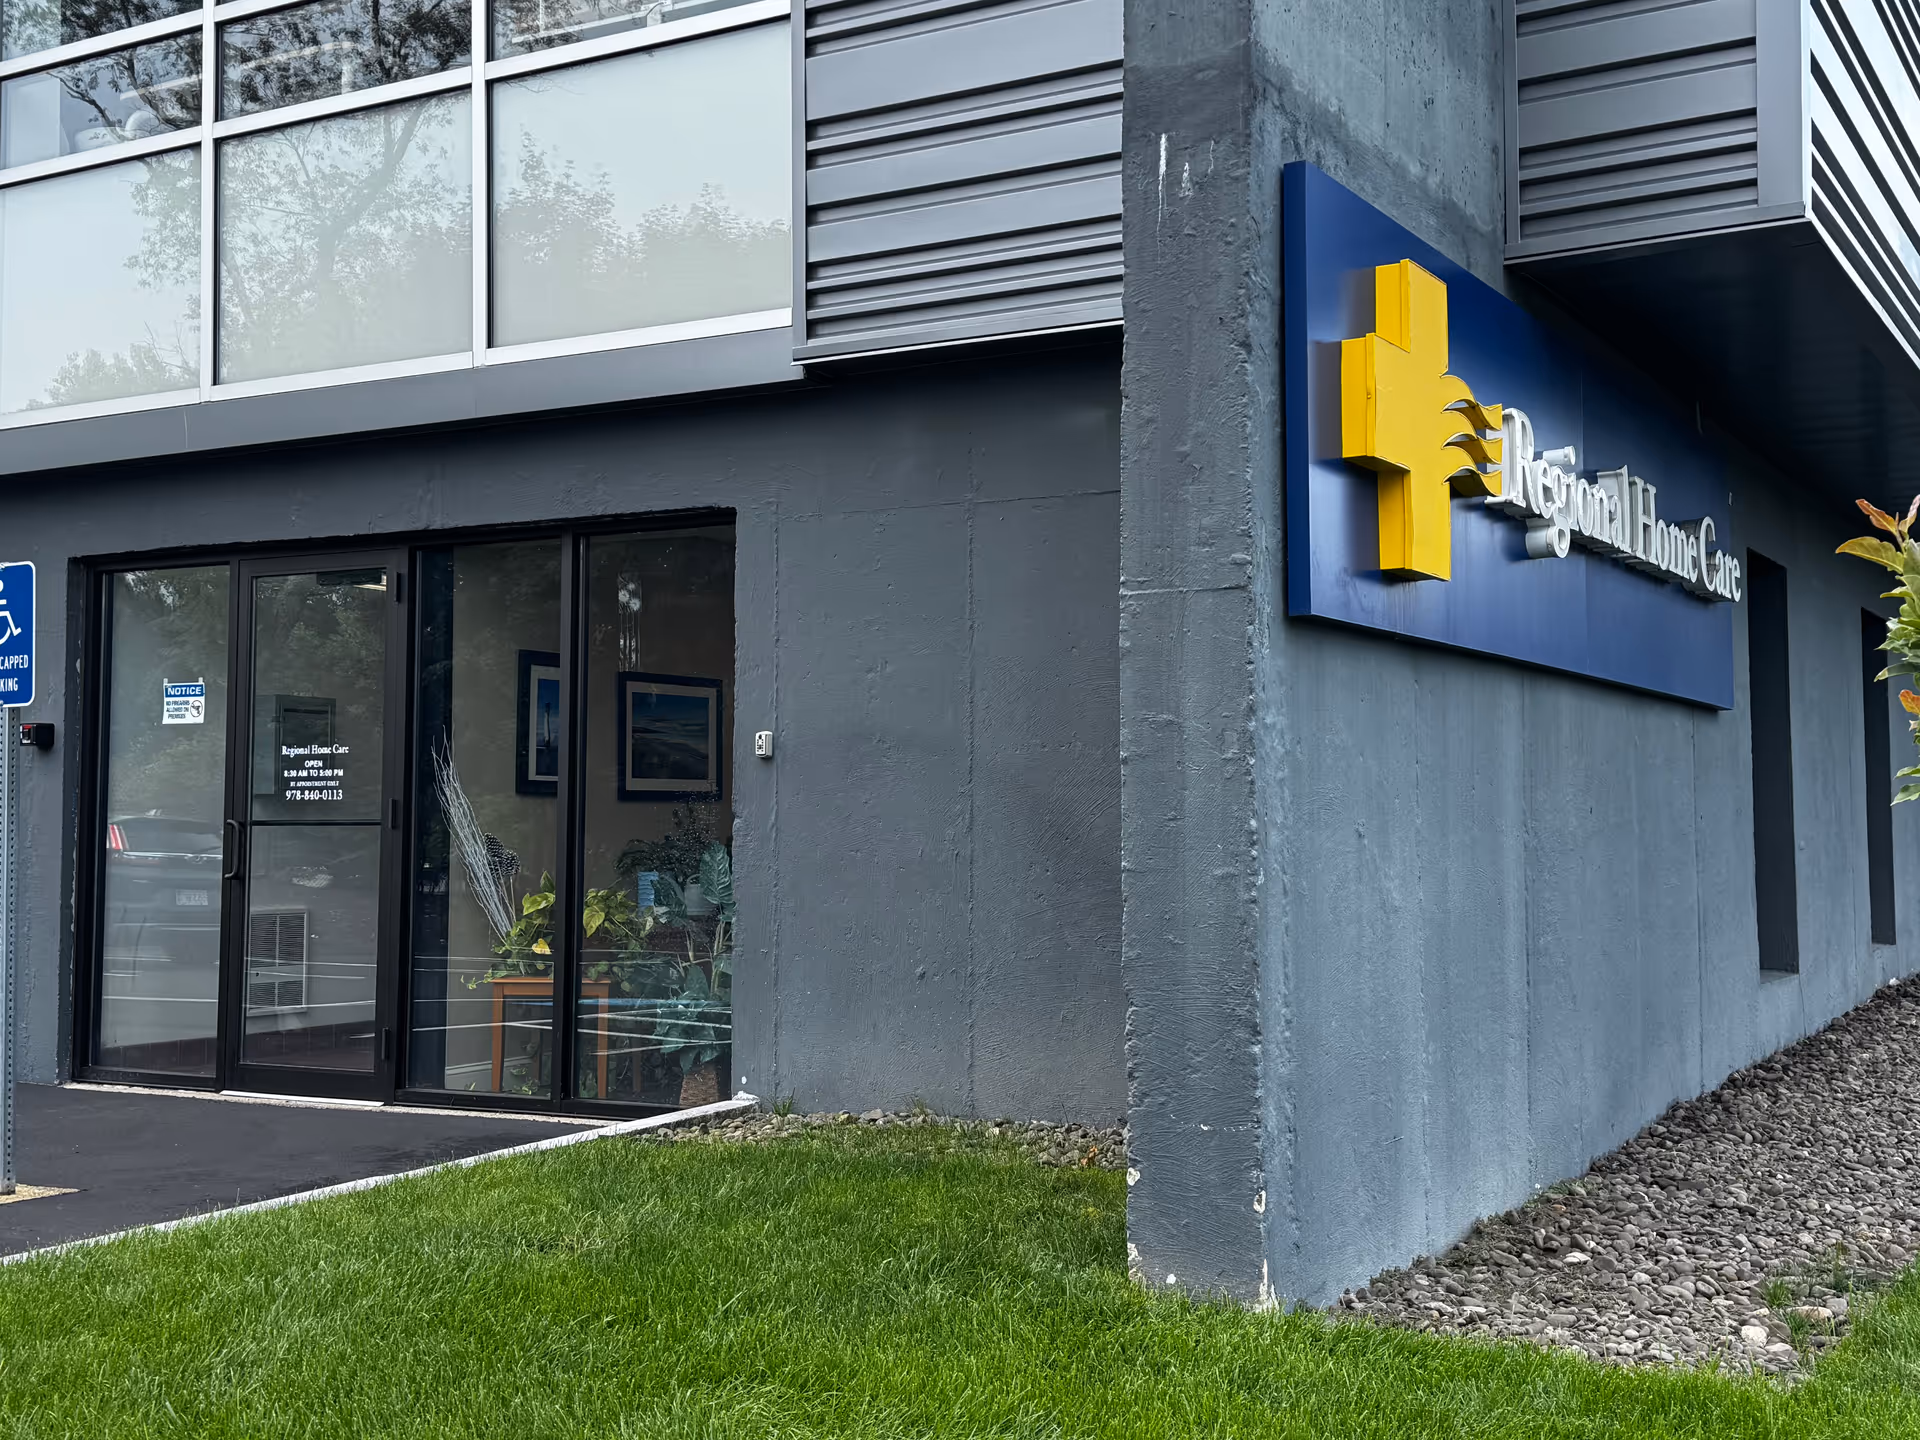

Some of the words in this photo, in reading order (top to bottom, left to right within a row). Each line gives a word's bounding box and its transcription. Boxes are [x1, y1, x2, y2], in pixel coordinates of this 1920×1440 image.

[1486, 408, 1631, 558] Regional
[1629, 475, 1698, 583] Home
[1699, 516, 1741, 602] Care
[167, 686, 202, 696] NOTICE
[281, 745, 310, 758] Regional
[311, 744, 332, 755] Home
[332, 743, 349, 754] Care
[304, 760, 323, 768] OPEN
[283, 769, 297, 777] 8:30
[297, 769, 308, 777] AM
[319, 769, 332, 777] 5:00
[333, 768, 344, 776] PM
[285, 789, 343, 801] 978-840-0113
